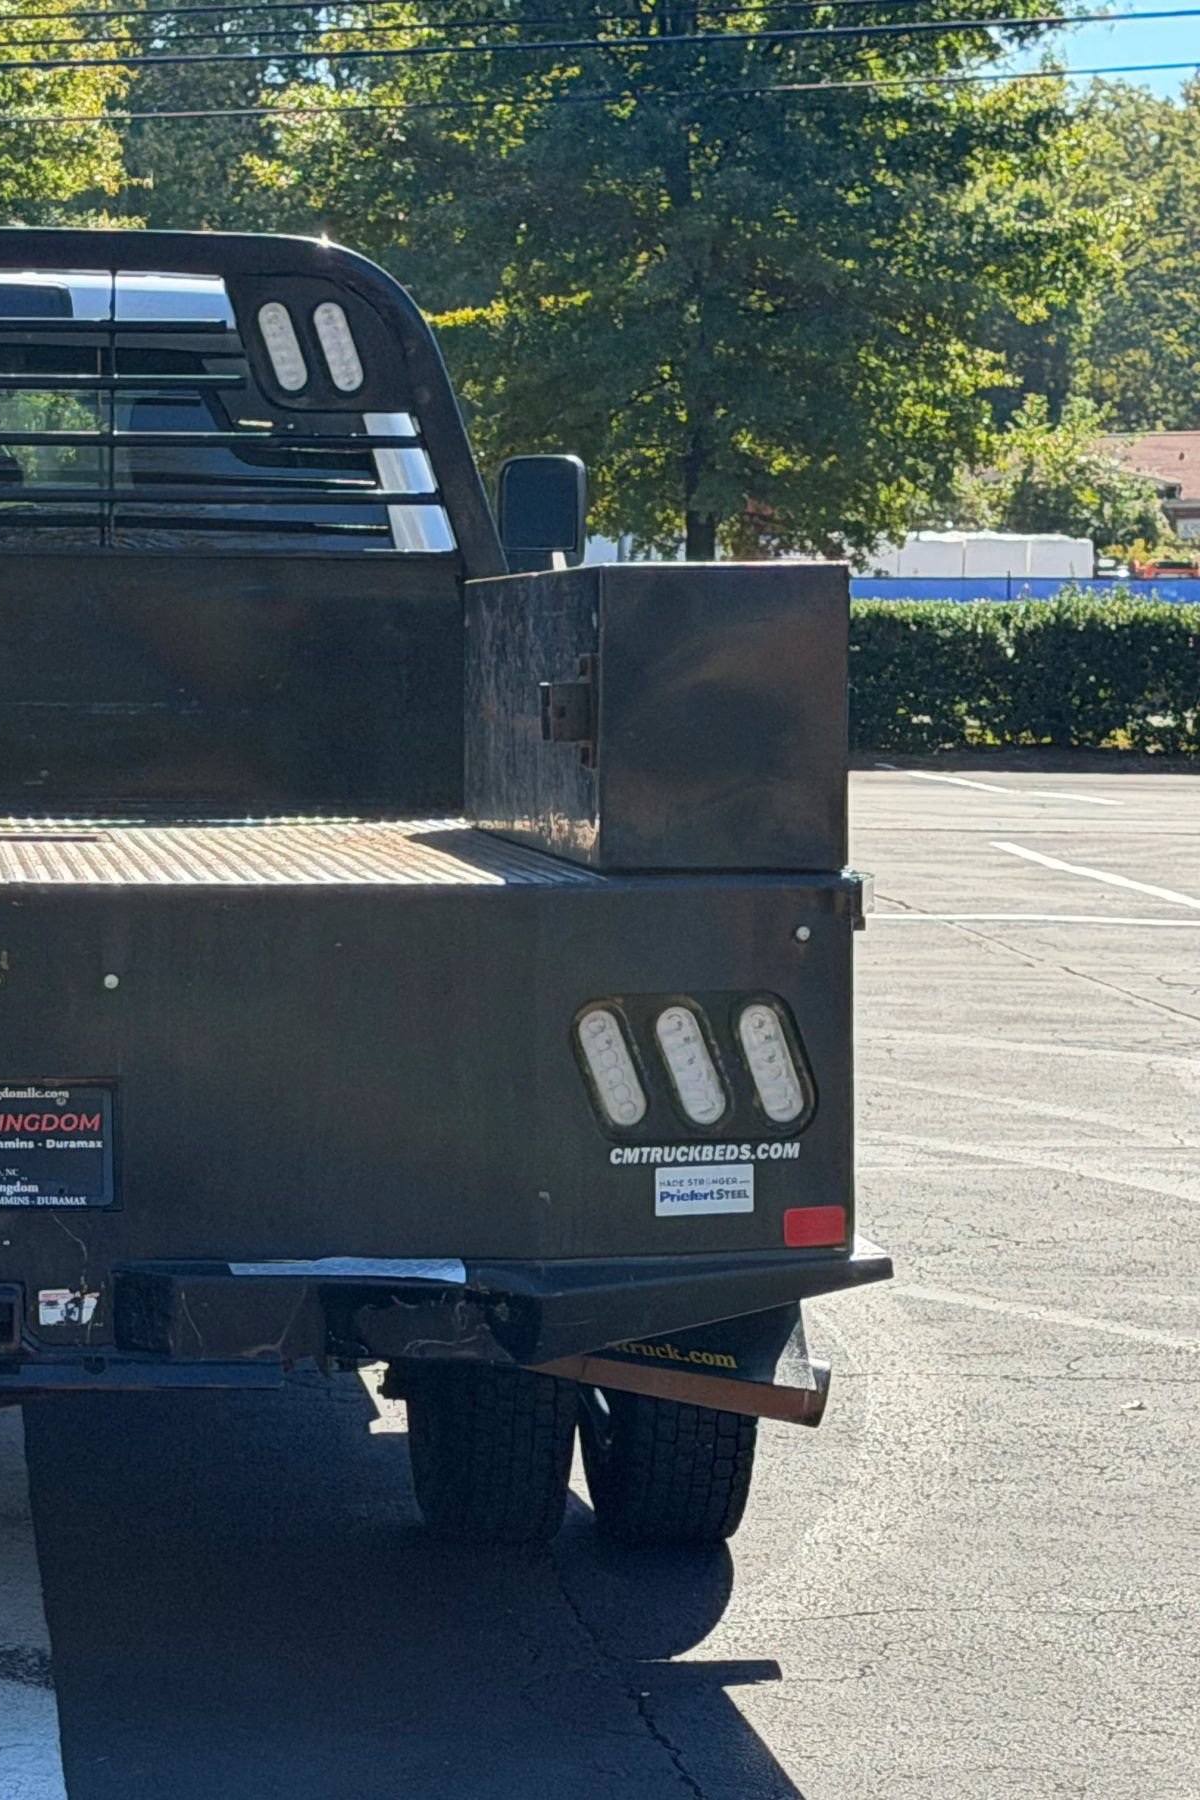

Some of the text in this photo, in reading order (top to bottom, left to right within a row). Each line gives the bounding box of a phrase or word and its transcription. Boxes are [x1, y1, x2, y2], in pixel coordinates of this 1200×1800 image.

[45, 1139, 103, 1149] Duramax
[609, 1142, 800, 1165] CMTRUCKBEDS.COM
[36, 1196, 87, 1206] DURAMAX
